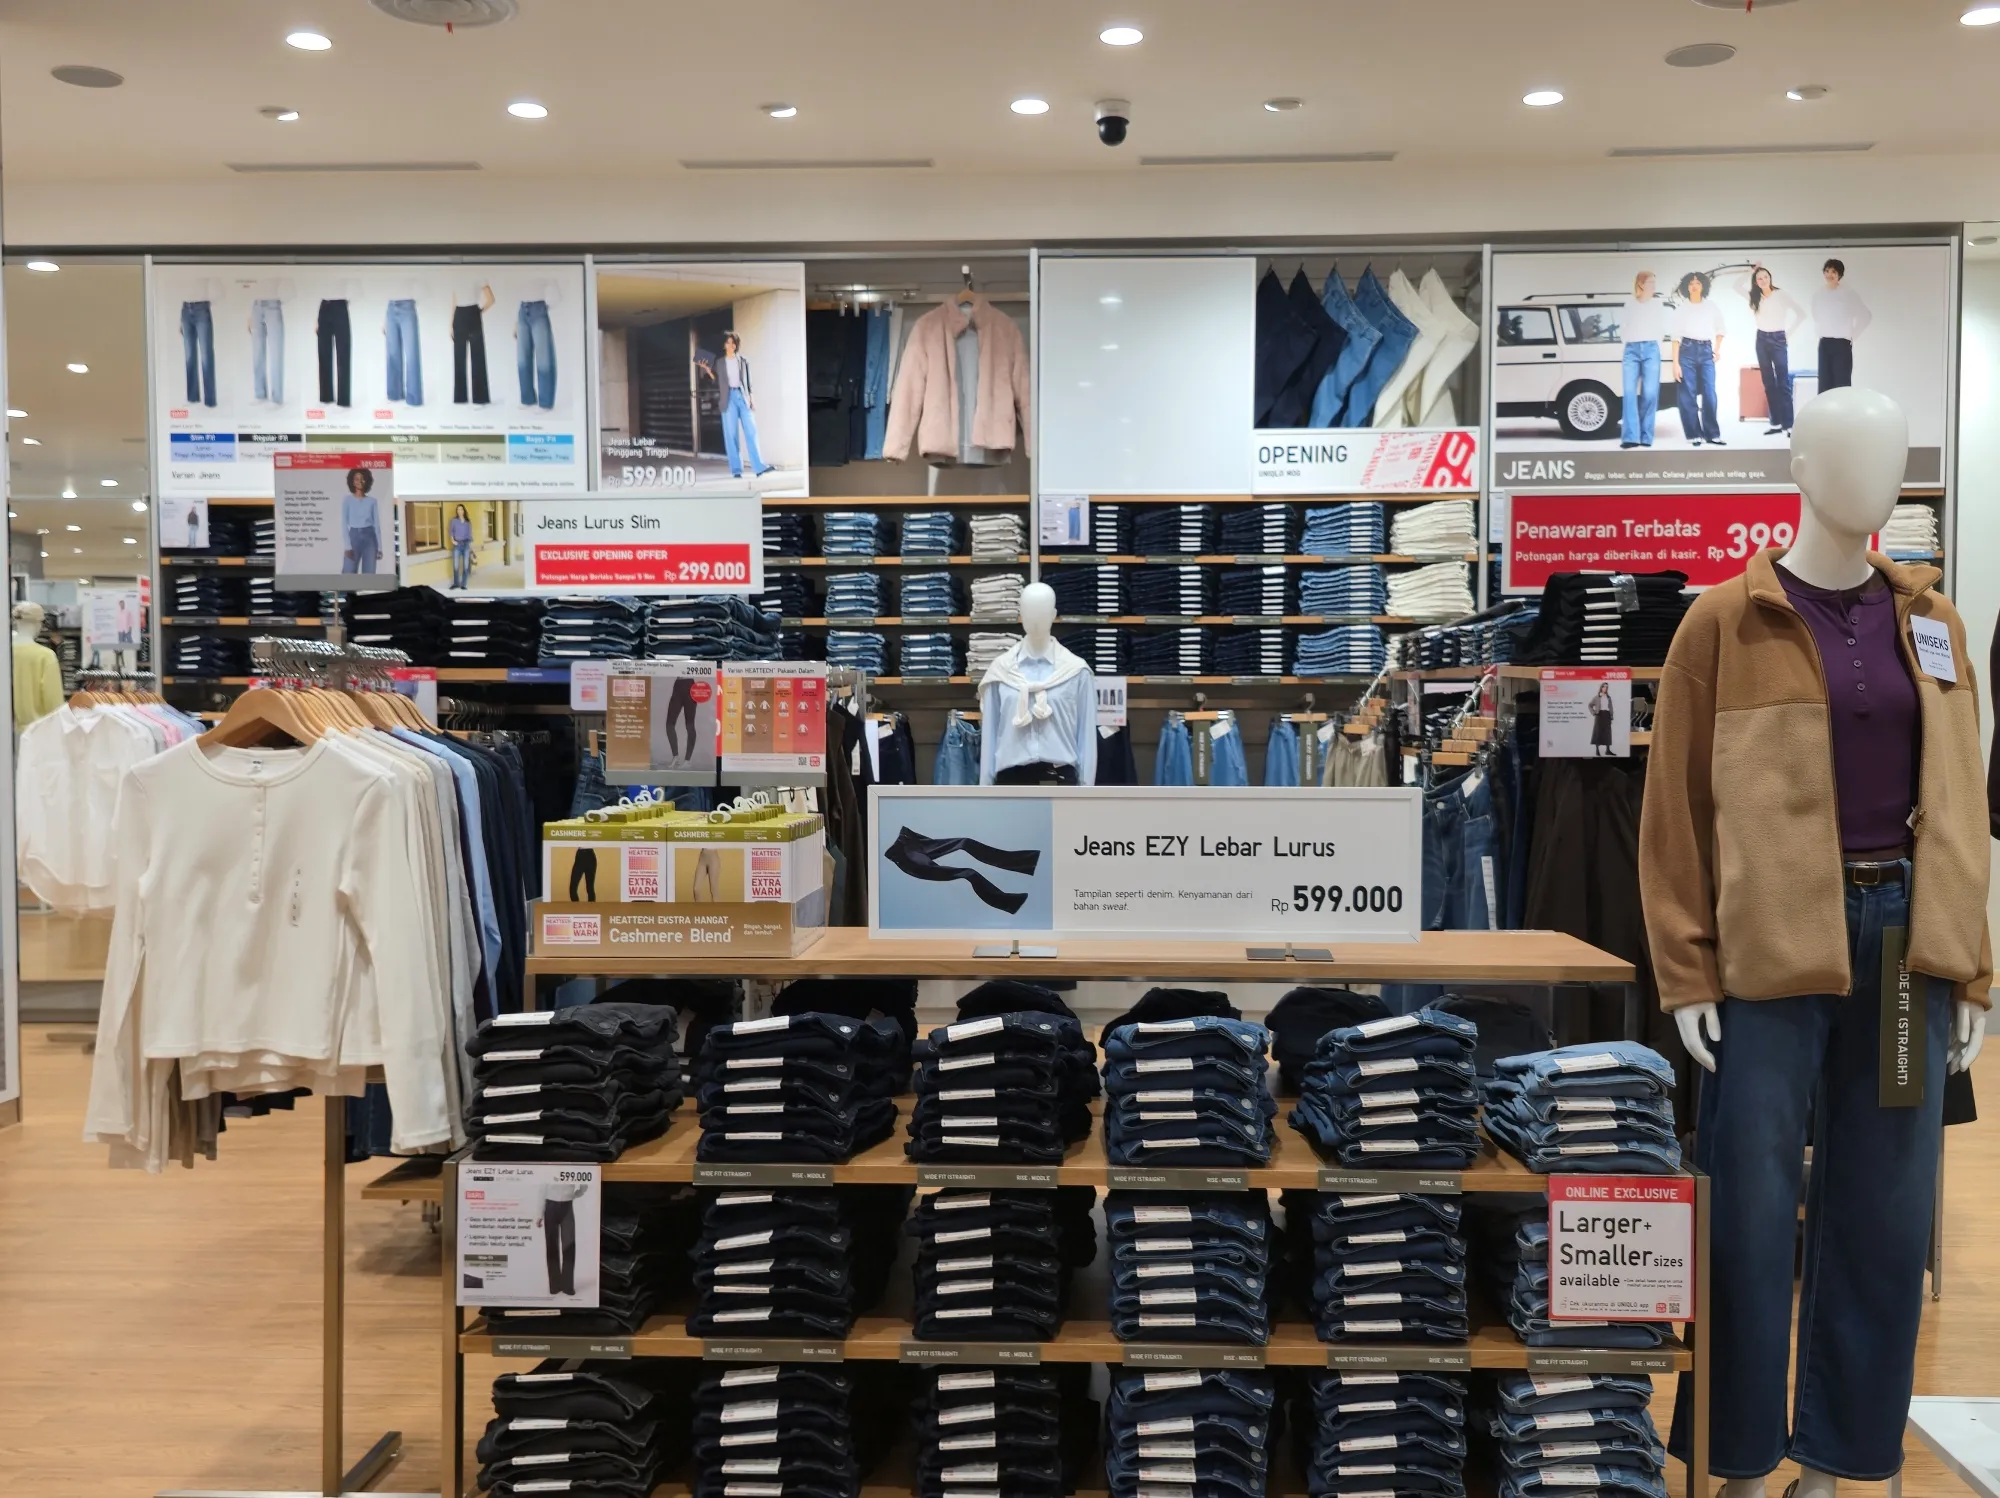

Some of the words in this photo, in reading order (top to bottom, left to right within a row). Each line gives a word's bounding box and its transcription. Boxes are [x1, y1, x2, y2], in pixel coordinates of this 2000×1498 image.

[608, 437, 630, 446] Jeans
[632, 436, 656, 446] Lebar
[608, 447, 642, 458] Pinggang
[645, 447, 669, 458] Tinggi
[1259, 445, 1348, 464] OPENING
[1503, 460, 1576, 480] JEANS
[537, 515, 578, 530] Jeans
[584, 515, 624, 530] Lurus
[630, 514, 660, 529] Slim
[1515, 520, 1617, 540] Penawaran
[1621, 518, 1701, 538] Terbatas
[540, 550, 590, 560] EXCLUSIVE
[592, 550, 634, 560] OPENING
[636, 550, 668, 560] OFFER
[1515, 550, 1566, 564] Potongan
[1568, 550, 1600, 563] harga
[1603, 549, 1654, 562] diberikan
[1656, 549, 1668, 560] di
[1671, 548, 1700, 560] kasir.
[1707, 546, 1725, 562] Rp
[664, 570, 676, 582] Rp
[678, 562, 746, 581] 299.000
[1914, 632, 1949, 651] UNISEKS
[686, 667, 712, 676] 299.000
[674, 830, 710, 838] CASHMERE
[1074, 835, 1135, 858] Jeans
[1145, 835, 1188, 857] EZY
[1200, 836, 1262, 858] Lebar
[1272, 836, 1336, 858] Lurus
[628, 878, 658, 886] EXTRA
[752, 878, 782, 887] EXTRA
[628, 886, 658, 896] WARM
[752, 887, 782, 896] WARM
[1074, 889, 1112, 900] Tampilan
[1115, 889, 1144, 900] seperti
[1147, 890, 1174, 898] denim.
[1178, 890, 1232, 900] Kenyamanan
[1236, 890, 1253, 899] dari
[1073, 902, 1100, 911] bahan
[1102, 902, 1129, 911] sweat.
[1271, 898, 1289, 916] Rp
[1292, 884, 1403, 914] 599.000
[609, 916, 655, 925] HEATTECH
[658, 916, 691, 924] EKSTRA
[694, 916, 728, 924] HANGAT
[609, 928, 683, 943] Cashmere
[1898, 992, 1910, 1012] FIT
[1897, 1016, 1909, 1086] (STRAIGHT)
[560, 1172, 592, 1182] 599.000
[1566, 1187, 1609, 1198] ONLINE
[1614, 1188, 1678, 1200] EXCLUSIVE
[1560, 1243, 1653, 1266] Smaller
[1654, 1255, 1683, 1268] sizes
[1560, 1274, 1620, 1287] available
